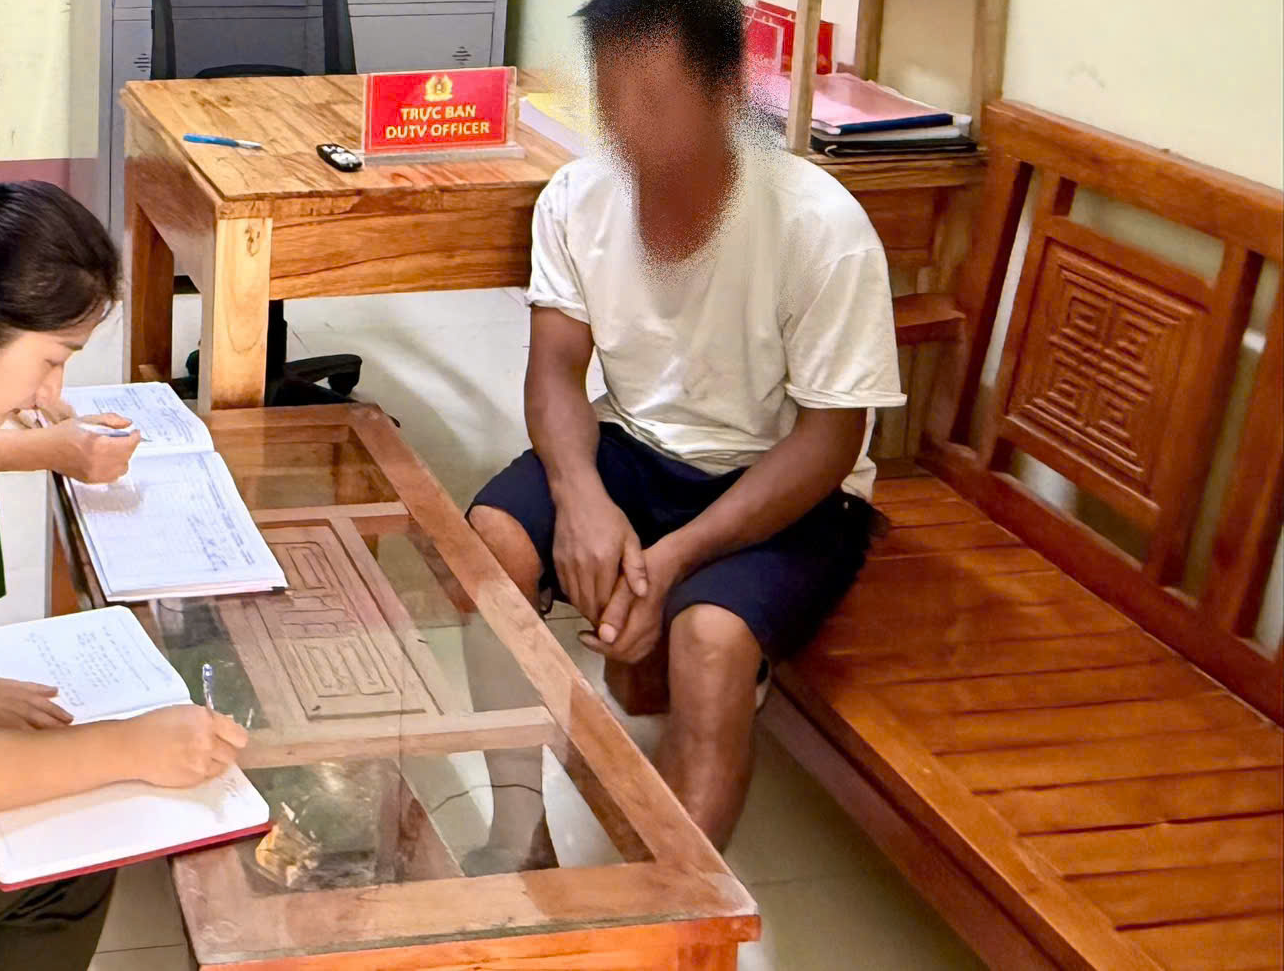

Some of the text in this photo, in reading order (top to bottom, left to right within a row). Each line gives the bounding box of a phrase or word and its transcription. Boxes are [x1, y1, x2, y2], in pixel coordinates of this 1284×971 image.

[400, 104, 476, 122] TRỰC BAN
[385, 121, 490, 139] DUTY OFFICER
